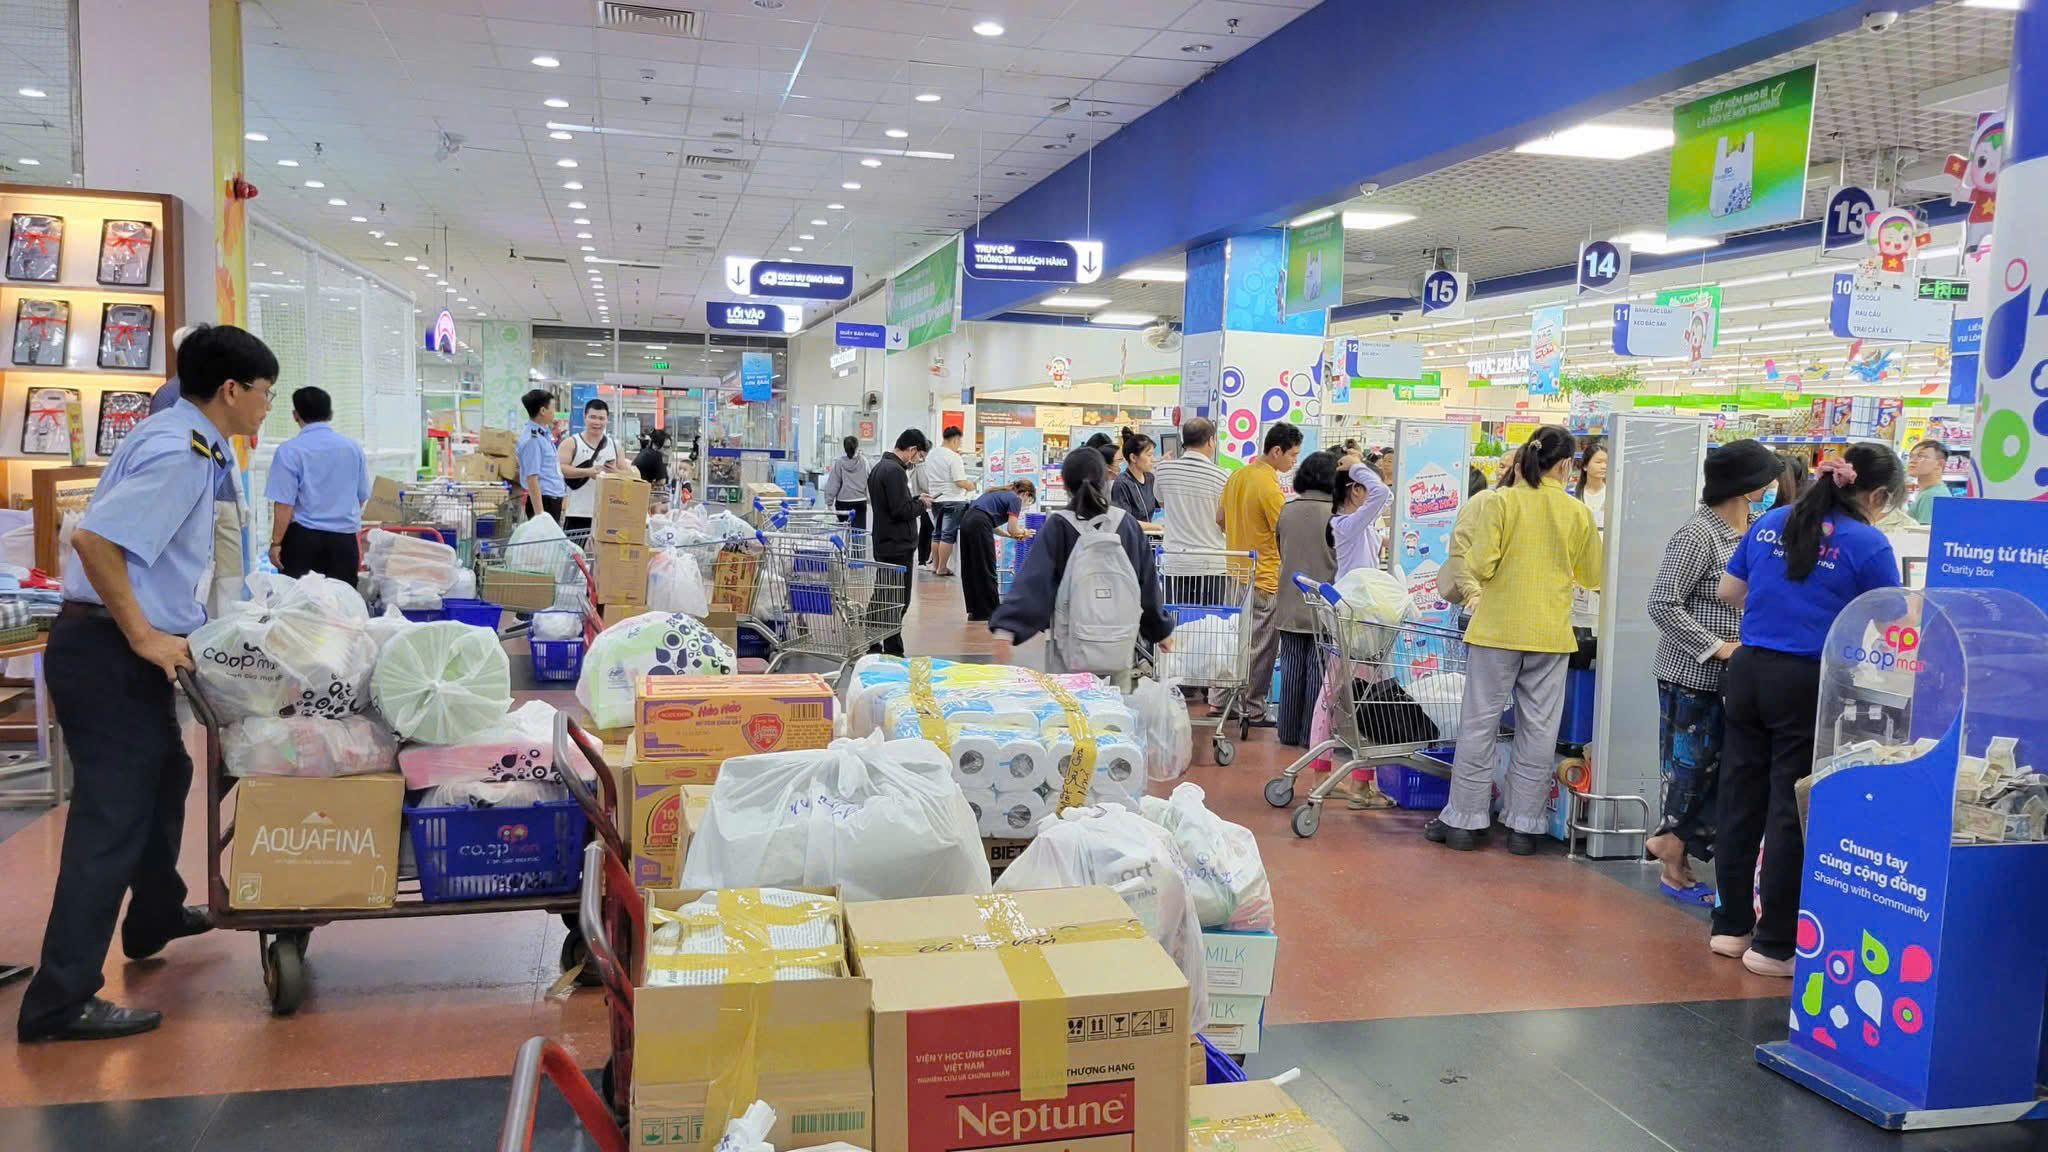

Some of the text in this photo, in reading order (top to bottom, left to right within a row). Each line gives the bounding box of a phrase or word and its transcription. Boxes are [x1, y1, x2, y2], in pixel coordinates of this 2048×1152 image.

[1833, 200, 1870, 235] 13
[1046, 256, 1069, 268] HÀNG
[1585, 251, 1616, 278] 14
[1428, 280, 1454, 303] 15
[1836, 279, 1852, 295] 10
[726, 306, 766, 320] LỐI VÀO
[1615, 308, 1629, 321] 11
[1348, 343, 1359, 353] 12
[1943, 541, 2048, 569] Thùng từ thiệ
[1941, 563, 1995, 578] Charity Box
[250, 824, 376, 858] AQUAFINA
[1840, 838, 1909, 873] Chung tay
[1819, 853, 1928, 902] cùng cộng đồng
[1814, 870, 1931, 922] Sharing with community
[1205, 946, 1248, 964] MILK
[1210, 1002, 1236, 1019] ILK
[916, 1053, 937, 1065] VIỆN
[937, 1053, 944, 1062] Y
[945, 1051, 964, 1064] HỌC
[965, 1046, 985, 1061] ỨNG
[943, 1061, 985, 1073] VIỆT NAM
[1107, 1062, 1136, 1076] HẠNG
[957, 1098, 1125, 1141] Neptune
